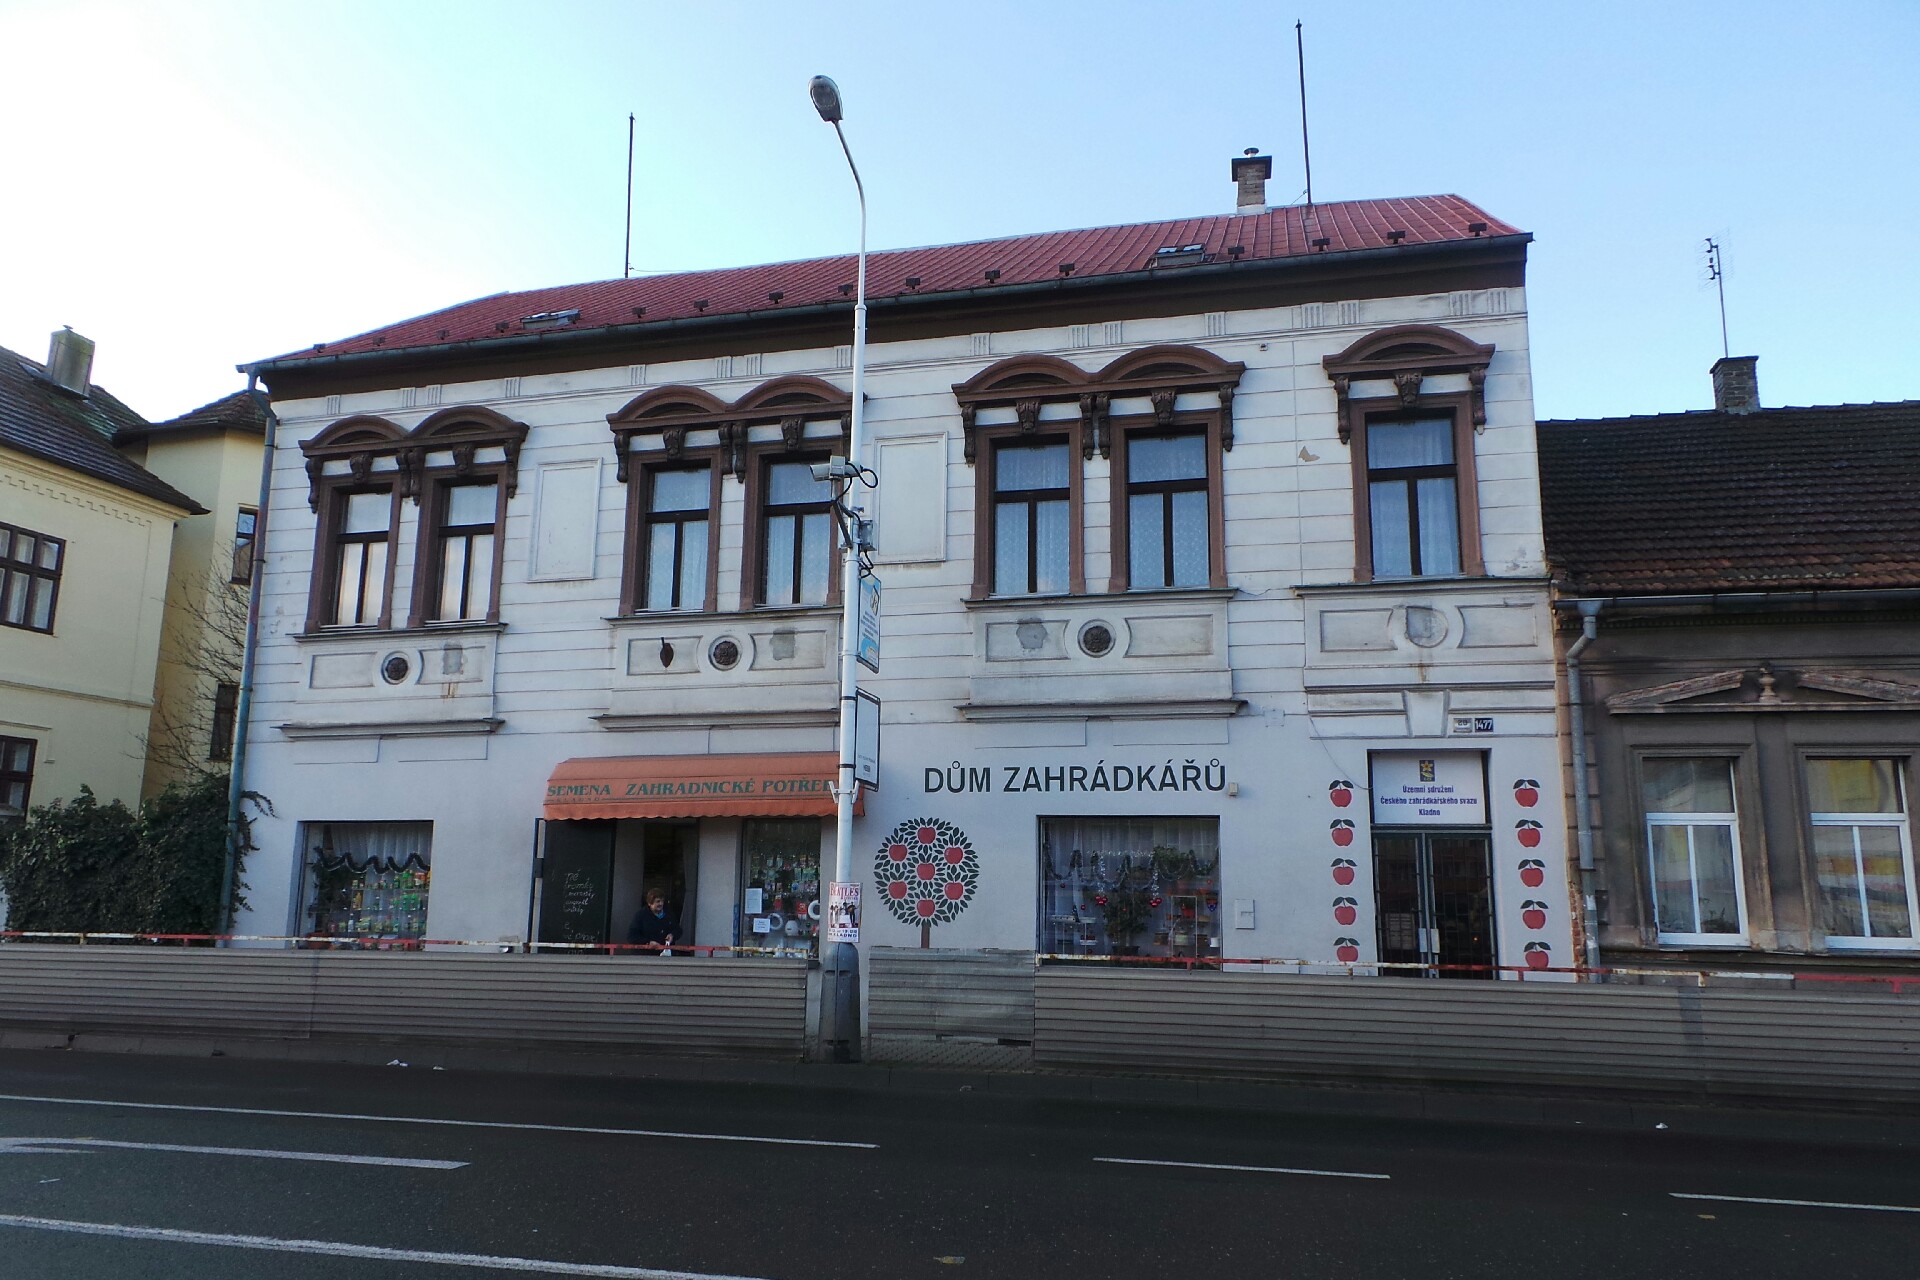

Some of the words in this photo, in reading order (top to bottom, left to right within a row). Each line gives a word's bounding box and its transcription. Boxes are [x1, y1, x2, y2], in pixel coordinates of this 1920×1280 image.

[1475, 719, 1492, 730] 1477
[924, 760, 991, 793] DŮM
[1003, 758, 1226, 792] ZAHRÁDKÁŘŮ
[546, 784, 611, 797] SEMENA
[625, 778, 756, 796] ZAHRADNICKÉ
[1427, 784, 1454, 793] sdružení
[1380, 795, 1407, 805] Českého
[1408, 796, 1459, 805] zahrádkářského
[1459, 797, 1478, 805] svazu
[1418, 808, 1441, 816] Kladno
